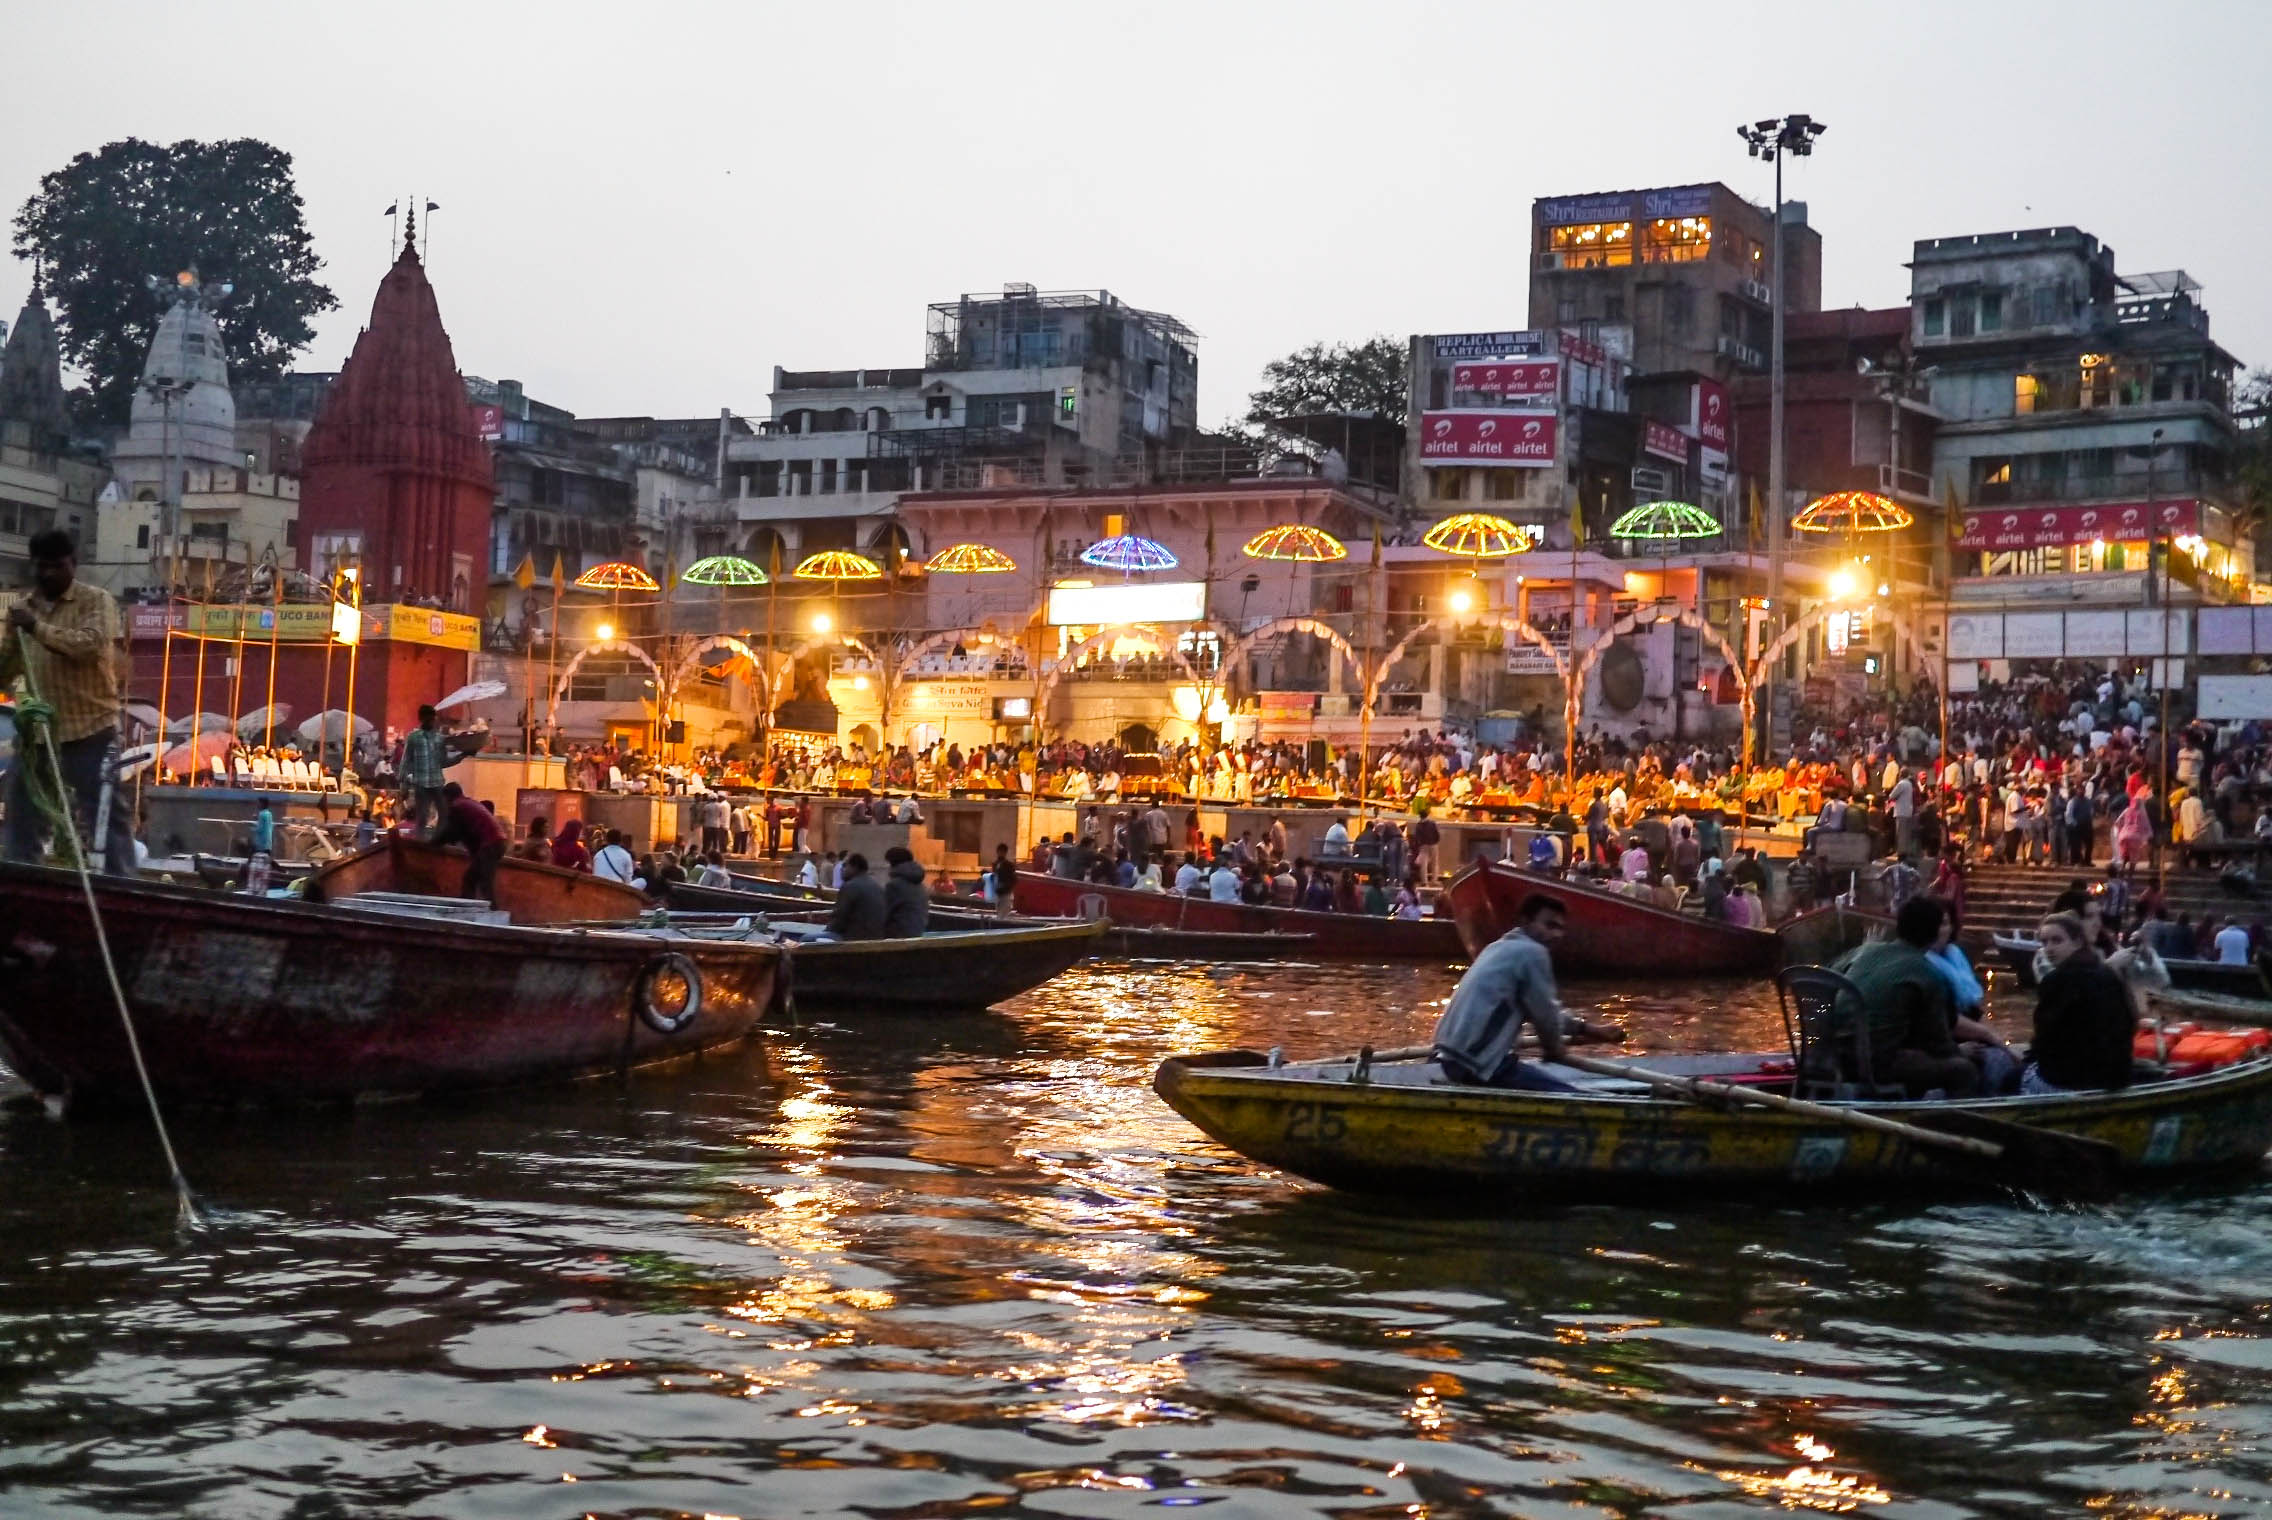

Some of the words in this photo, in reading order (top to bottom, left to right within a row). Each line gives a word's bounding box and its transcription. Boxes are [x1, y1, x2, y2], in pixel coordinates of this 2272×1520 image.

[1437, 335, 1493, 347] REPLICA
[1702, 420, 1725, 441] airtel
[1425, 440, 1459, 453] airtel
[1468, 440, 1502, 454] airtel
[1513, 441, 1547, 455] airtel
[1995, 534, 2025, 544] airtel
[2034, 531, 2064, 543] airtel
[2114, 526, 2145, 540] airtel
[278, 610, 302, 621] UCO
